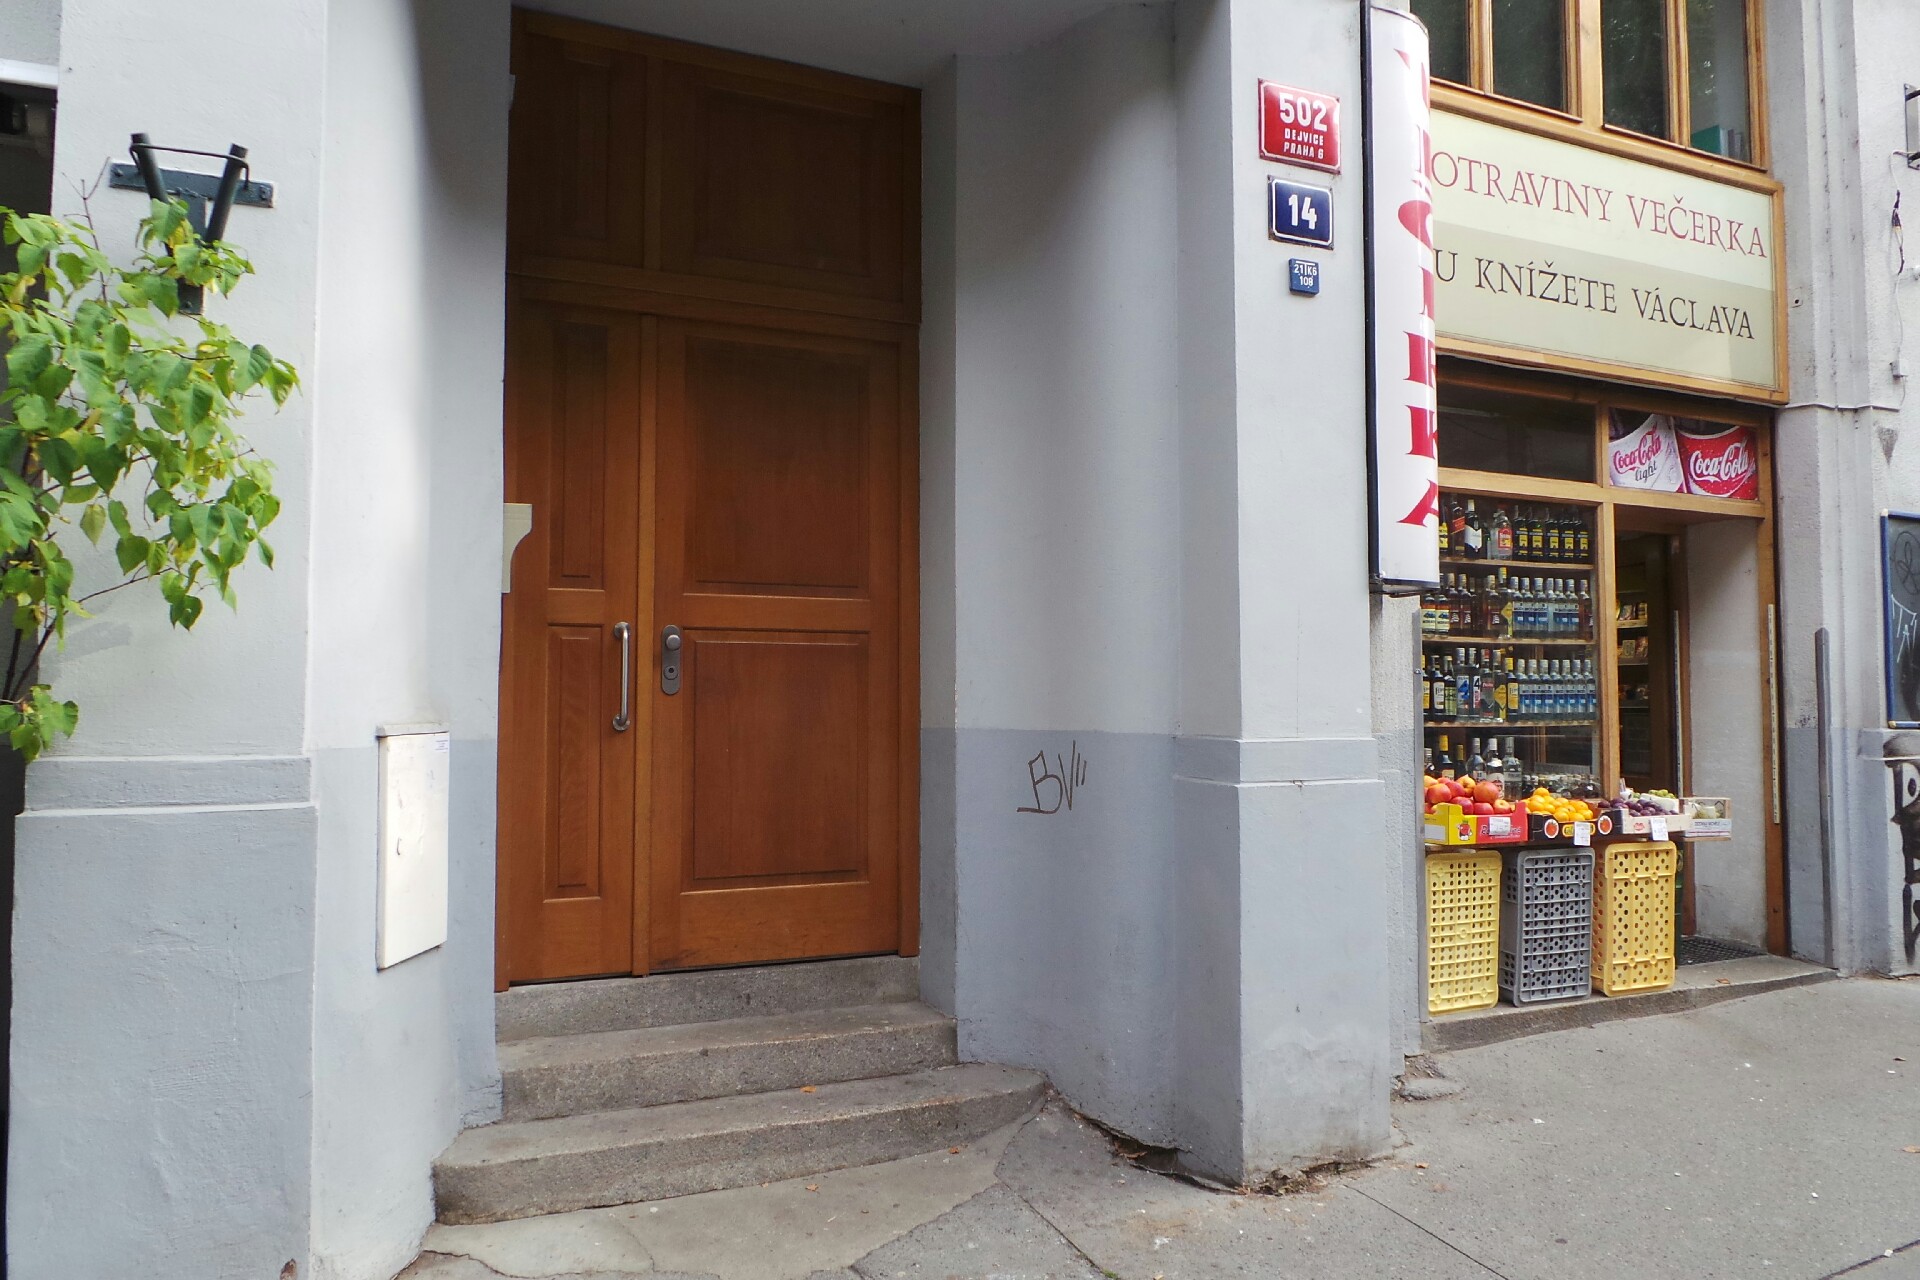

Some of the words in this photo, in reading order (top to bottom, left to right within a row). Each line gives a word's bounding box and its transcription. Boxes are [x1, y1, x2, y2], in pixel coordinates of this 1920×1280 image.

[1280, 92, 1328, 132] 502
[1284, 141, 1315, 157] PRAHA
[1317, 148, 1324, 159] 6
[1285, 128, 1324, 146] DEJVICE
[1288, 194, 1317, 229] 14
[1431, 151, 1613, 221] OTRAVINY
[1626, 194, 1767, 258] VEČERKA
[1475, 257, 1617, 314] KNÍŽETE
[1632, 287, 1755, 340] VÁCLAVA
[1634, 460, 1657, 482] light
[1690, 438, 1749, 482] Coca-Cola
